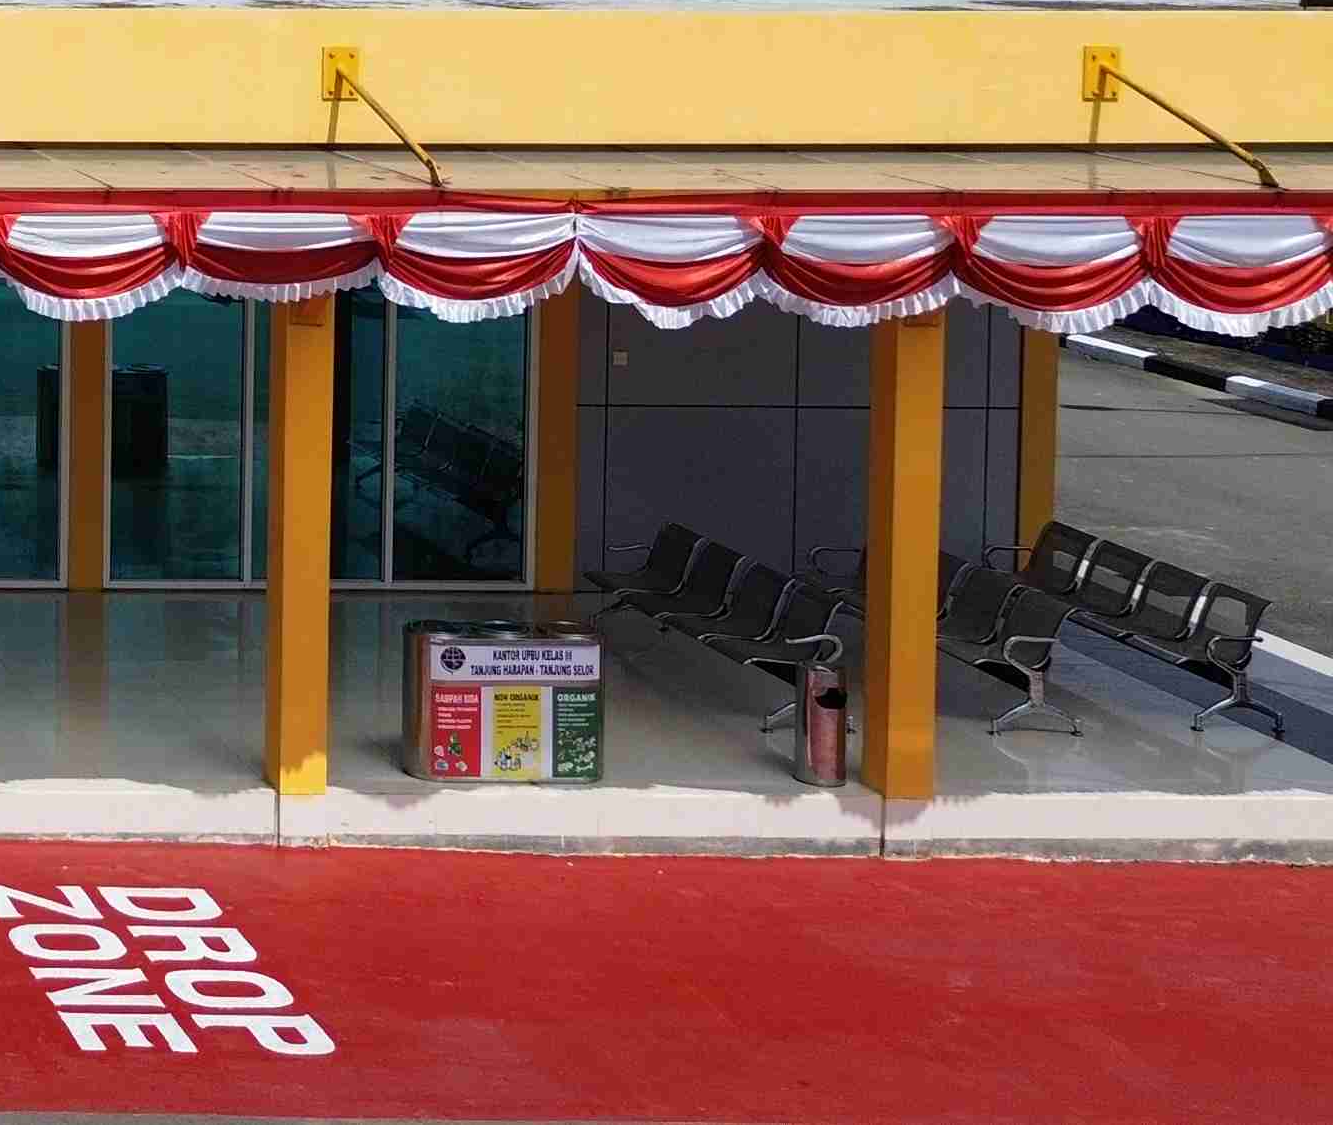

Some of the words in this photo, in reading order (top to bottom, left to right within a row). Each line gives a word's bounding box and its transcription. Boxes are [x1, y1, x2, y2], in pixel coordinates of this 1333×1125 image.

[492, 650, 520, 661] KANTOR
[541, 650, 564, 661] KELAS
[470, 664, 501, 676] TANJUNG
[502, 664, 534, 676] HARAPAN
[539, 664, 572, 676] TANJUNG
[556, 693, 596, 702] ORGANIK
[97, 885, 336, 1056] DROP
